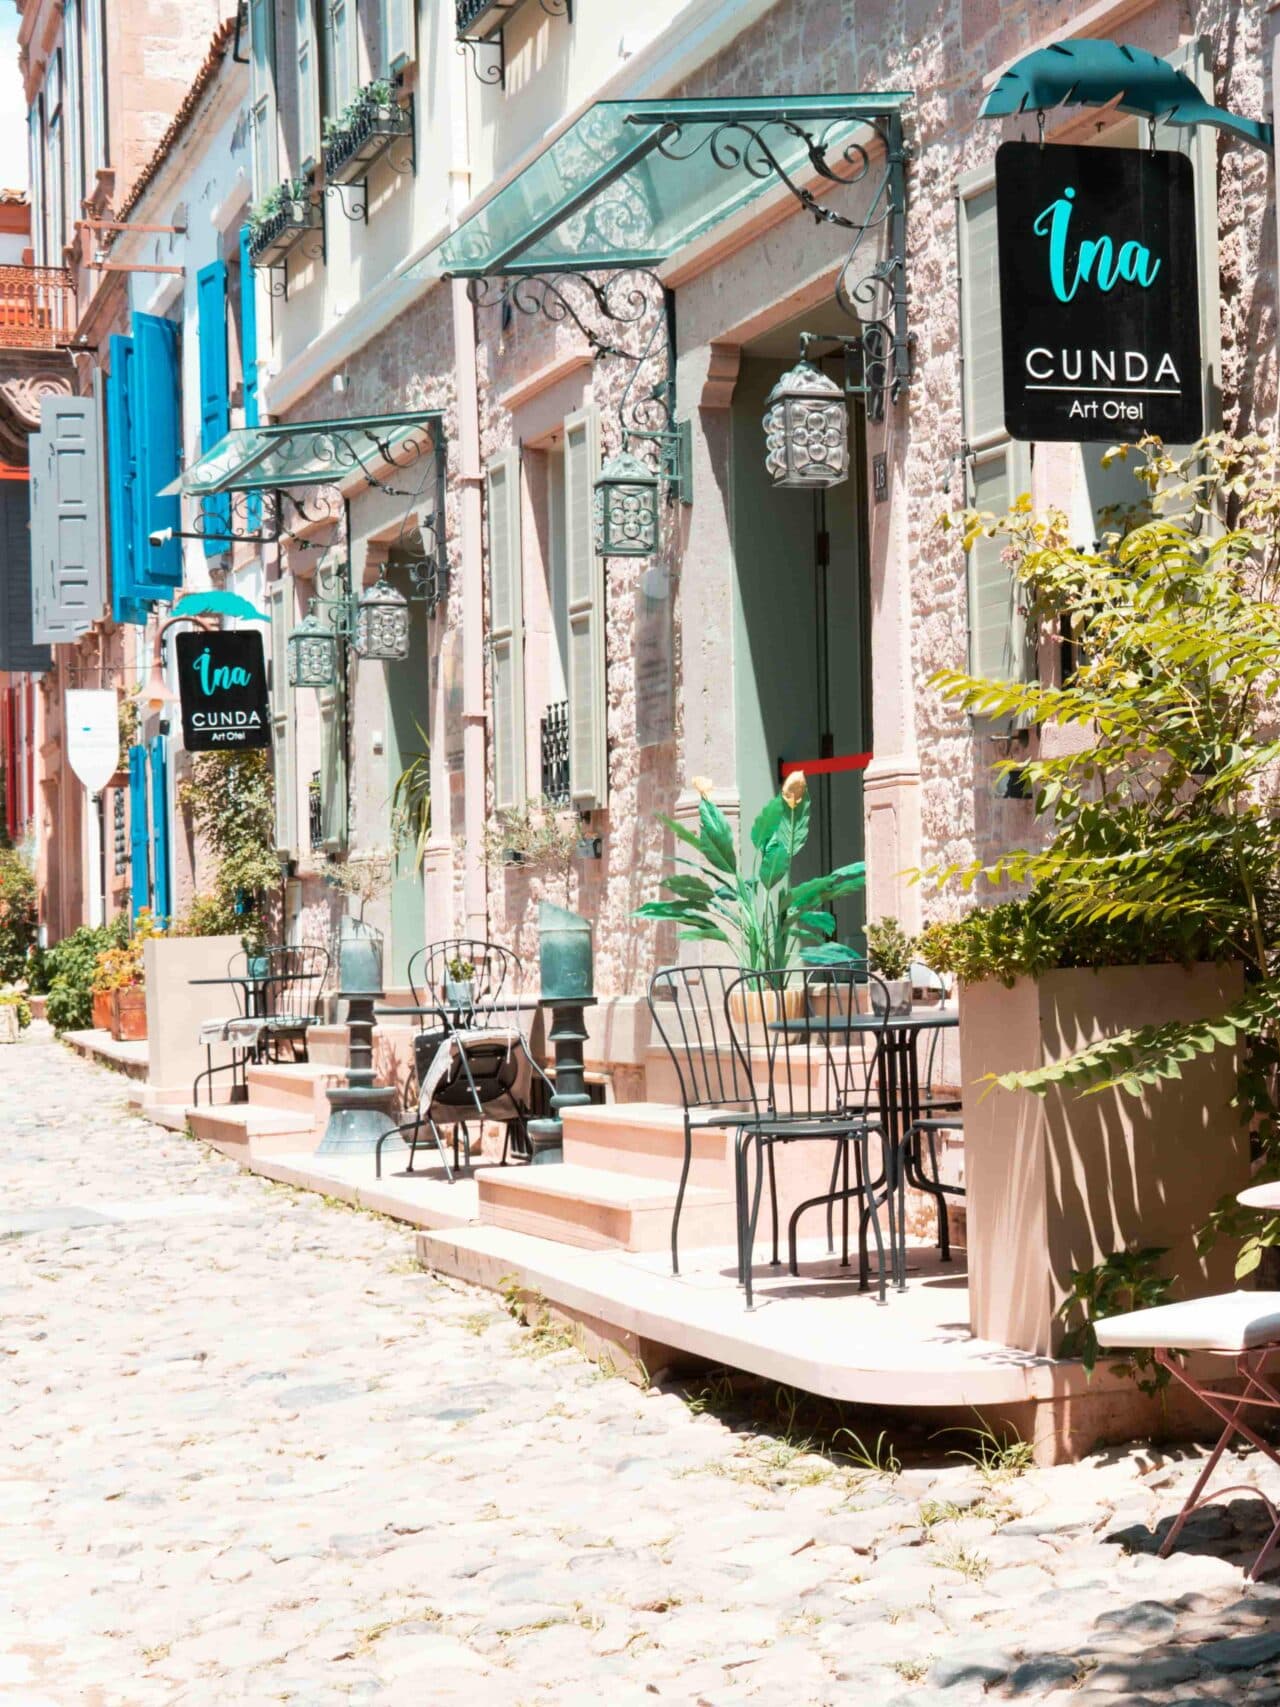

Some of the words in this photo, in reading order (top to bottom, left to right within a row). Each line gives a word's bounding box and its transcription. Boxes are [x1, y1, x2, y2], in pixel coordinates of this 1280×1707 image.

[1025, 347, 1181, 383] CUNDA
[1069, 399, 1098, 419] Art
[1103, 400, 1144, 420] Otel
[191, 711, 261, 727] CUNDA
[211, 732, 225, 741] Art
